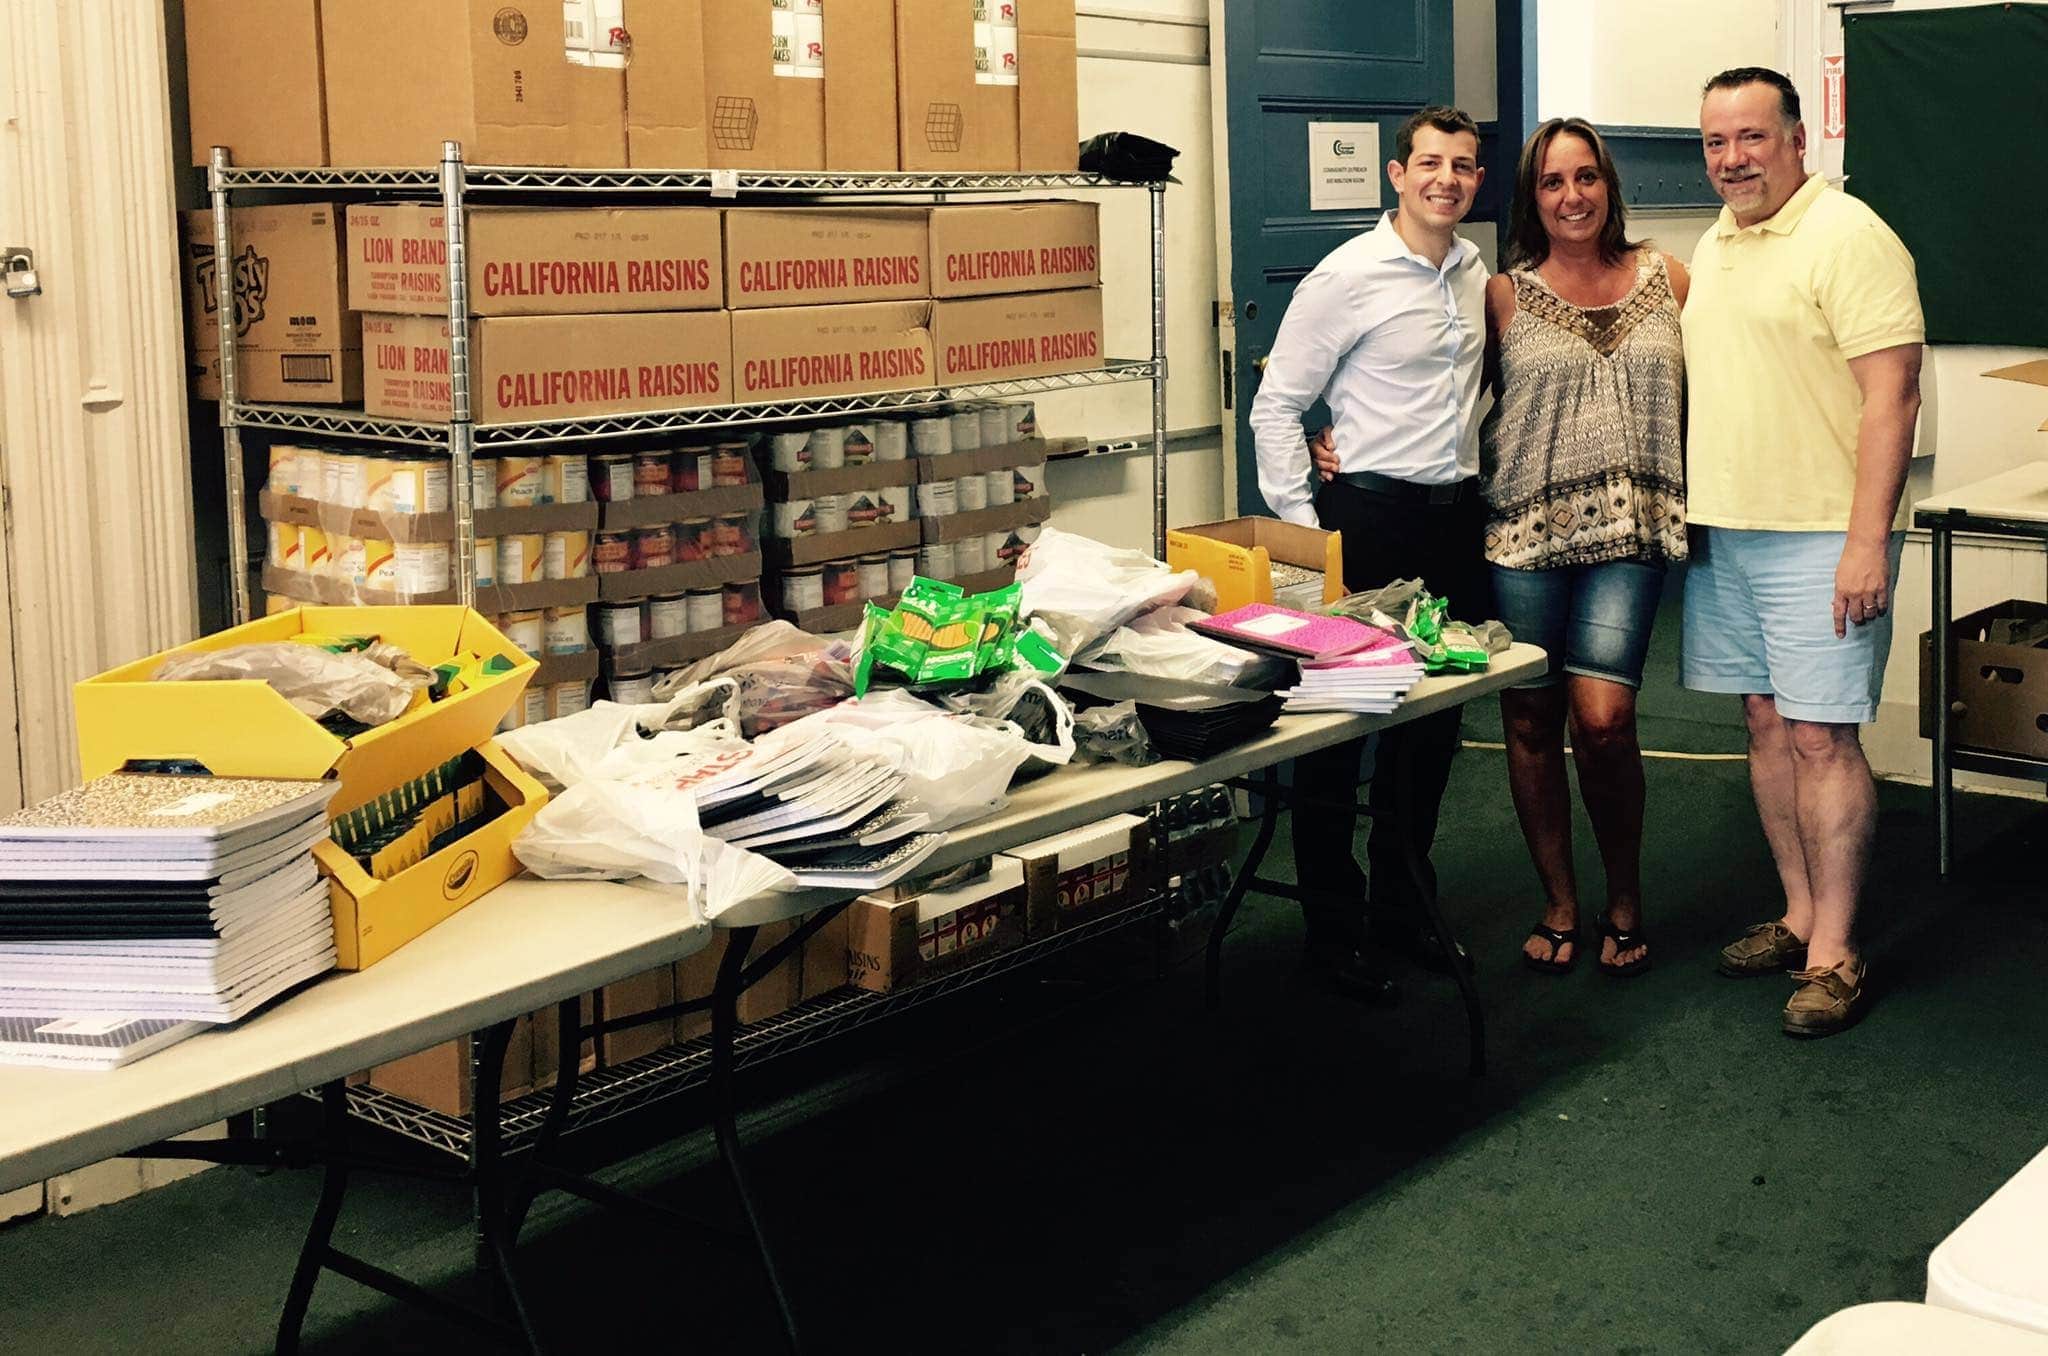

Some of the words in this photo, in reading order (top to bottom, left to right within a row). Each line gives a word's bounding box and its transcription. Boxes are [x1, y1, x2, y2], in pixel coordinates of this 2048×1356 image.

[1825, 67, 1842, 75] FIRE
[363, 238, 394, 264] LION
[402, 239, 447, 266] BRAND
[946, 247, 1037, 283] CALIFORNIA
[1040, 244, 1096, 276] RAISINS
[400, 272, 442, 293] RAISINS
[483, 260, 621, 297] CALIFORNIA
[626, 257, 711, 293] RAISINS
[739, 257, 848, 294] CALIFORNIA
[852, 254, 920, 287] RAISINS
[377, 344, 406, 371] LION
[413, 346, 449, 375] BRAN
[743, 350, 854, 392] CALIFORNIA
[858, 345, 926, 382] RAISINS
[946, 337, 1038, 374] CALIFORNIA
[1040, 330, 1098, 362] RAISINS
[412, 380, 452, 403] RAISINS
[497, 366, 631, 409] CALIFORNIA
[637, 360, 721, 399] RAISINS
